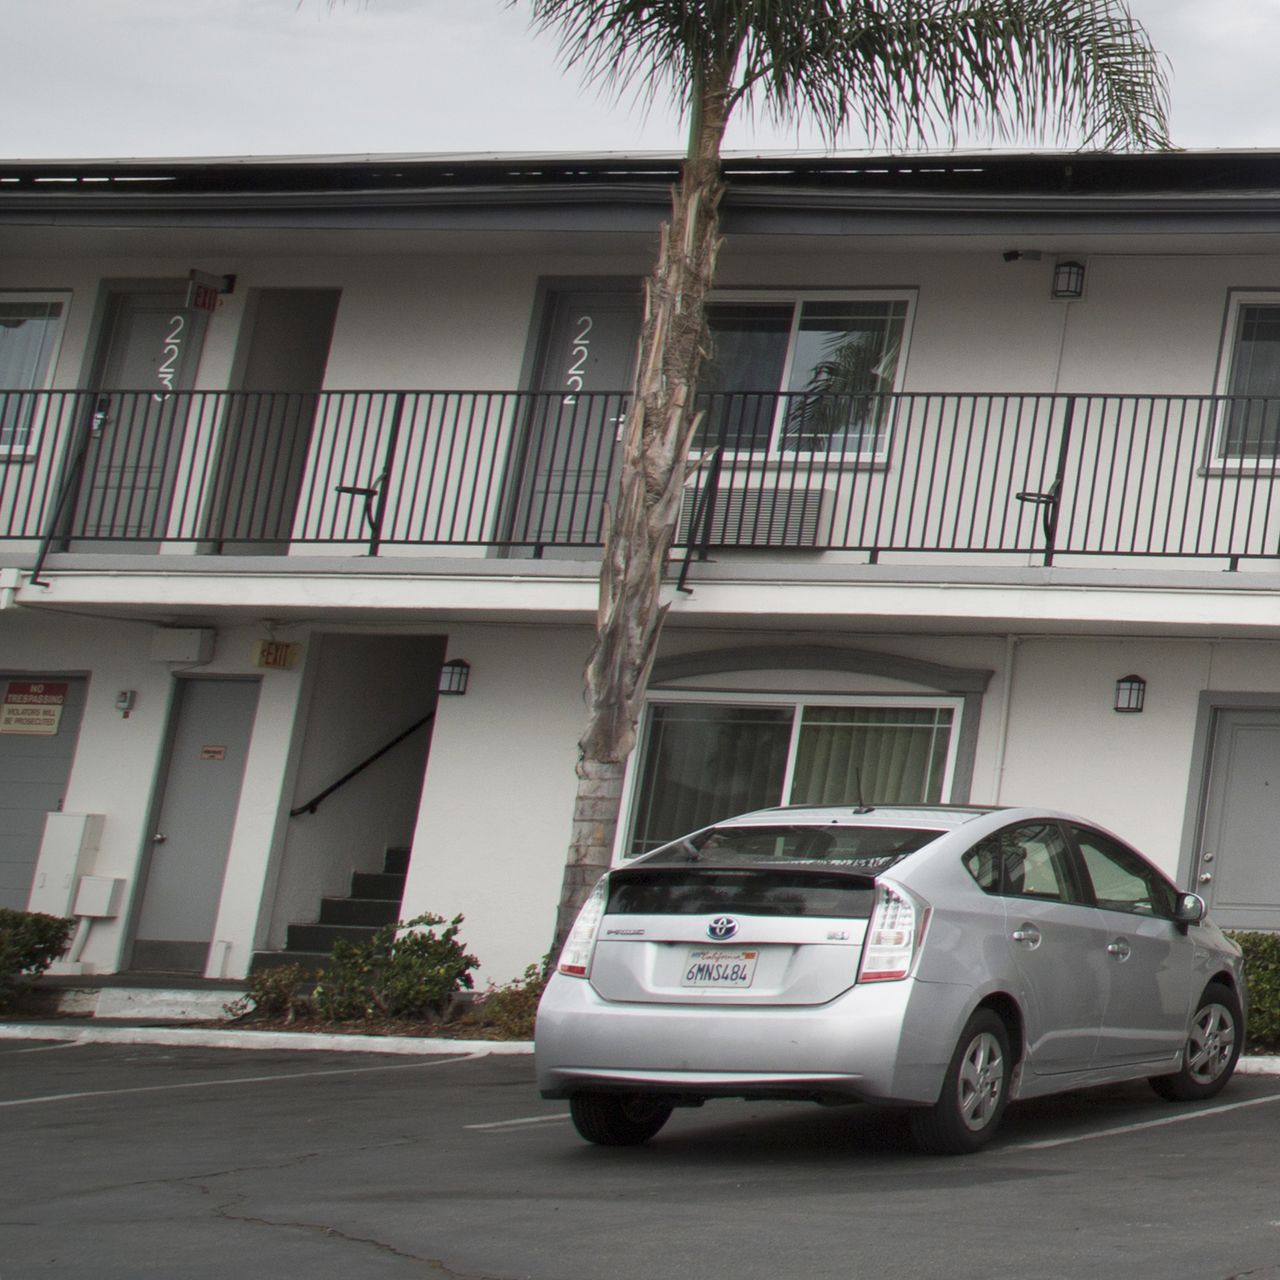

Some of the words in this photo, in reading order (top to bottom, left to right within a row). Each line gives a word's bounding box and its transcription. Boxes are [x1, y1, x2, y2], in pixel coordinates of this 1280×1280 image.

[193, 285, 218, 312] EXIT
[152, 315, 185, 402] 223
[563, 316, 593, 404] 222
[265, 642, 290, 667] EXIT
[7, 694, 65, 705] TRESPASSING
[31, 684, 45, 694] NO
[686, 963, 748, 982] 6MNS484
